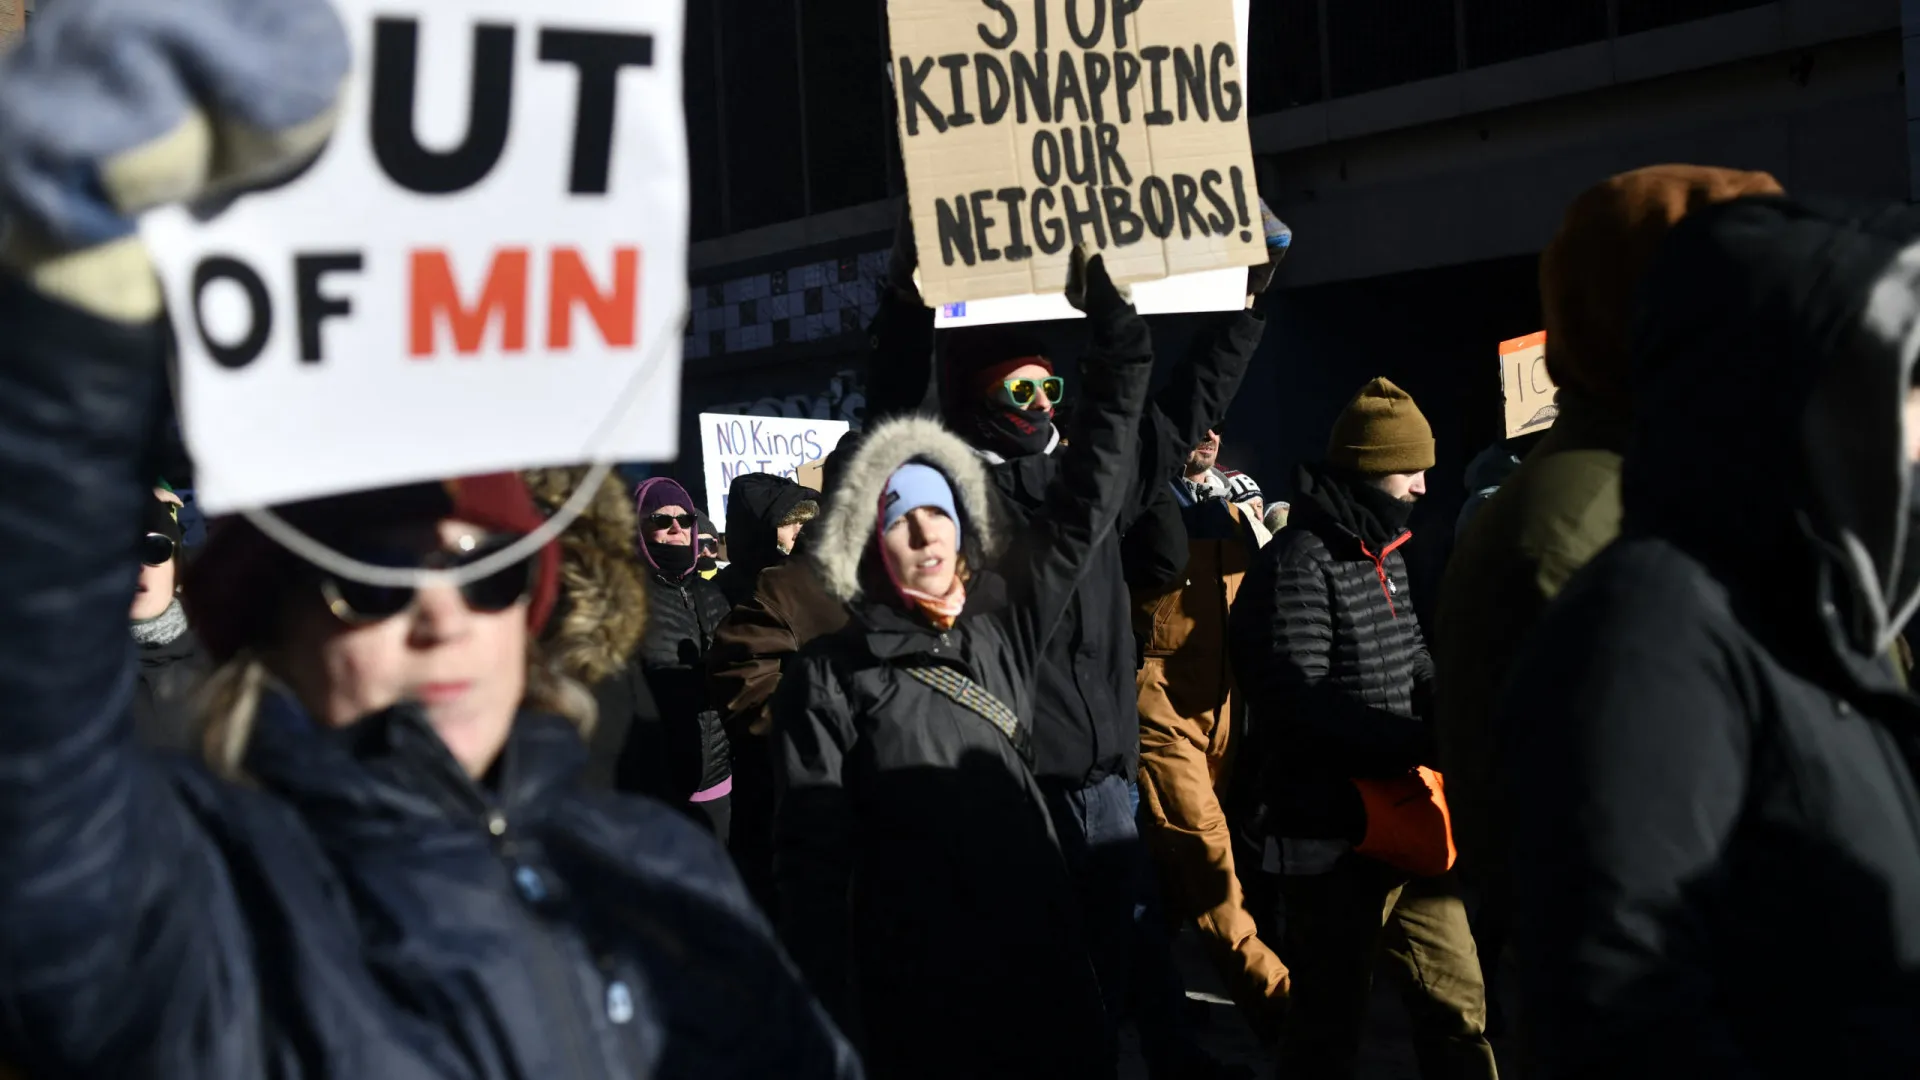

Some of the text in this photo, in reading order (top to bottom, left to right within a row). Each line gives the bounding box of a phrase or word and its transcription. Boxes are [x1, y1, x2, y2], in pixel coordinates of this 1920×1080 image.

[900, 42, 1242, 136] KIDNAPPING
[1031, 122, 1133, 188] OUR
[934, 166, 1253, 267] NEIGHBORS!
[191, 247, 640, 369] OF MN
[716, 420, 747, 456] NO
